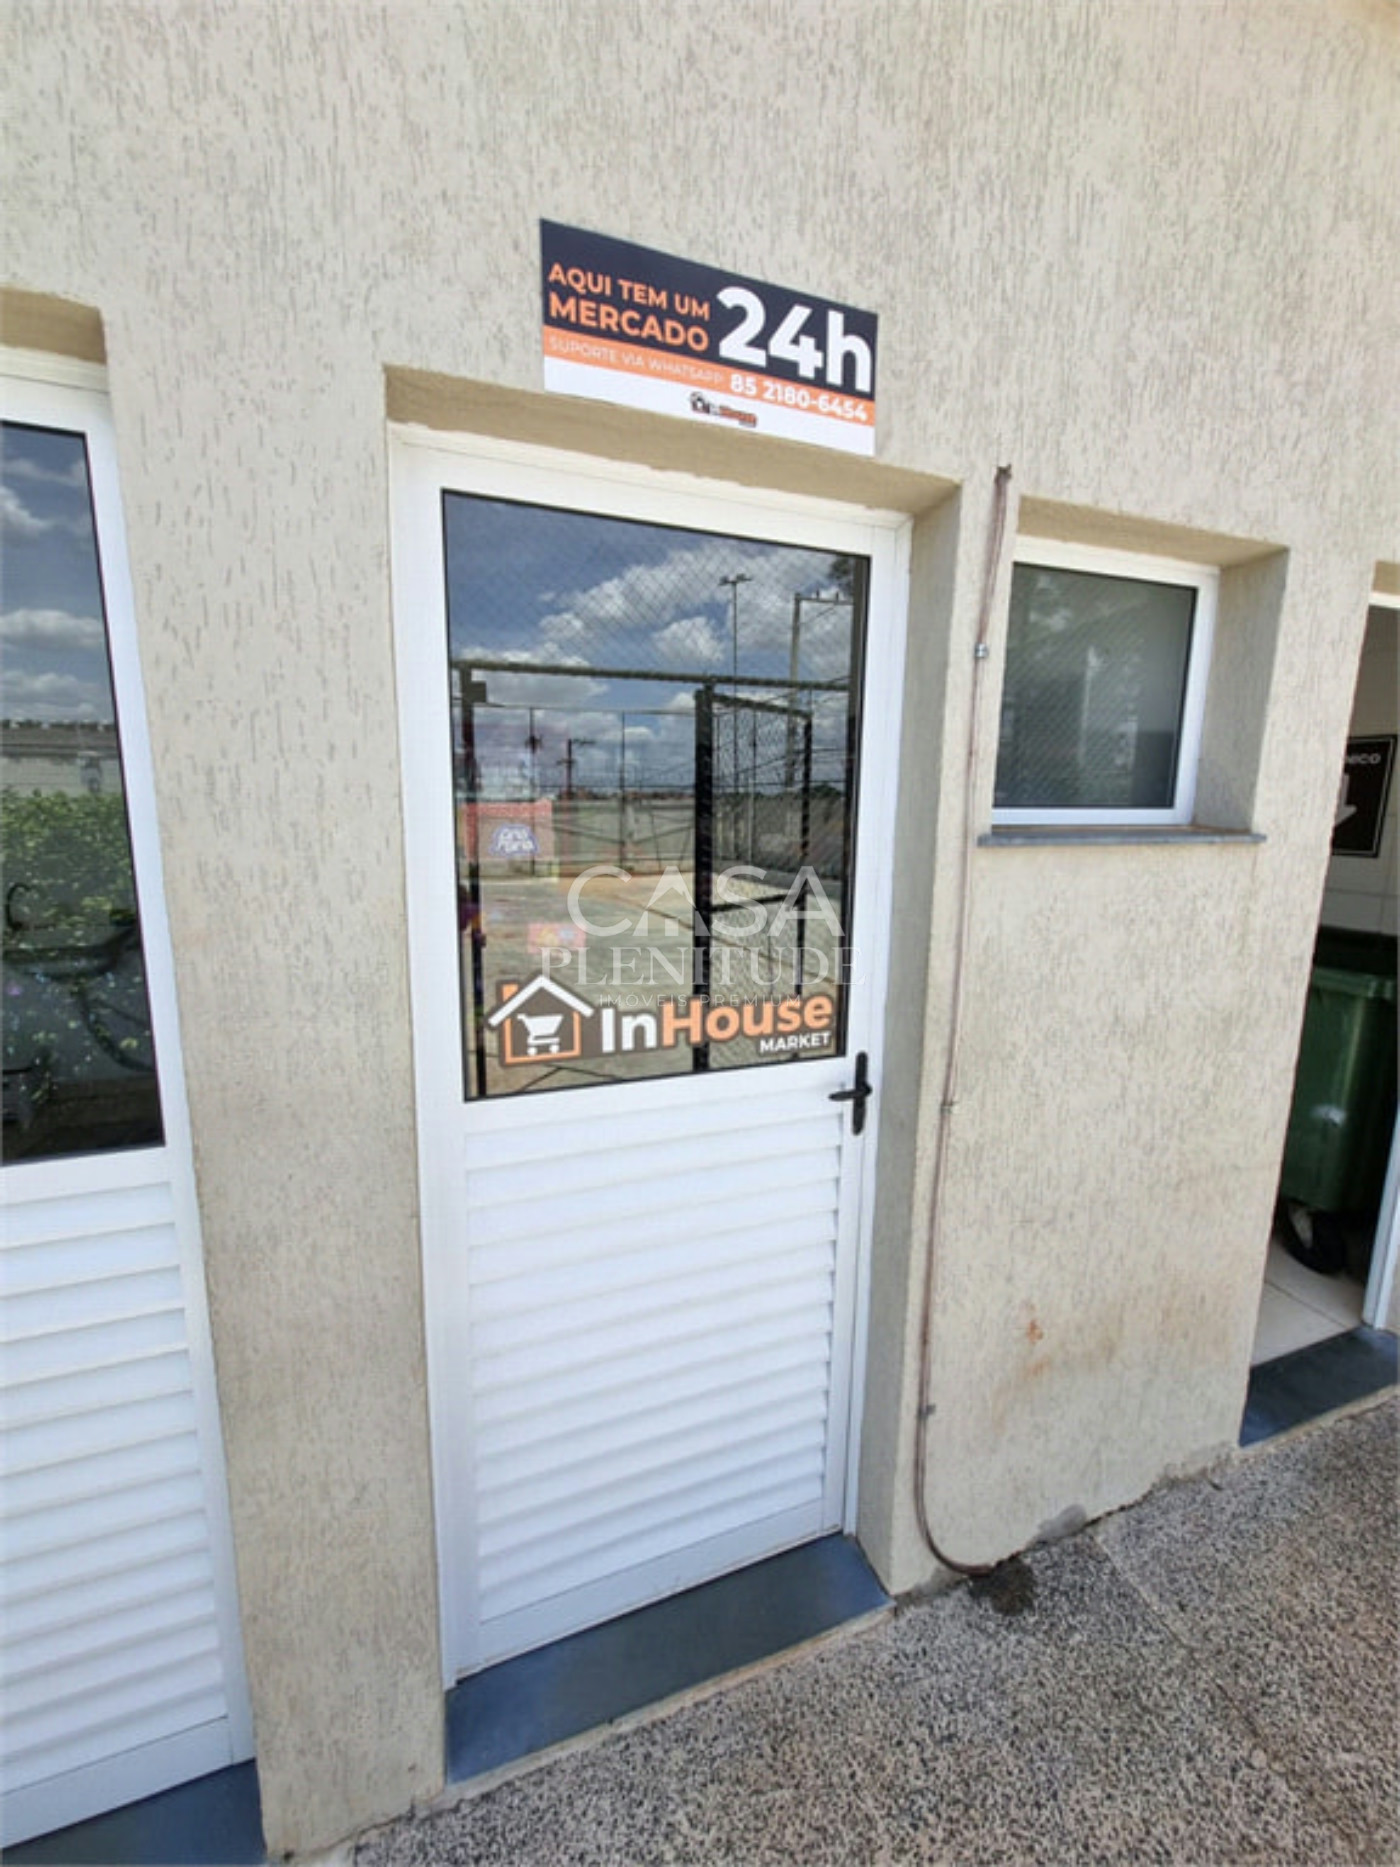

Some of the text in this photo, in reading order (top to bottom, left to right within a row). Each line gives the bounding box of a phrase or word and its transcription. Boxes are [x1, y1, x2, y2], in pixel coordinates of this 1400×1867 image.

[548, 291, 710, 352] MERCADO
[549, 263, 710, 321] AQUI TEM UM
[716, 286, 872, 393] 24h
[549, 336, 618, 364] SUPORTE
[621, 351, 645, 368] VIA
[730, 373, 758, 396] 85
[763, 380, 868, 422] 2180-6454
[601, 994, 833, 1055] InHouse
[759, 1030, 832, 1054] MARKET
